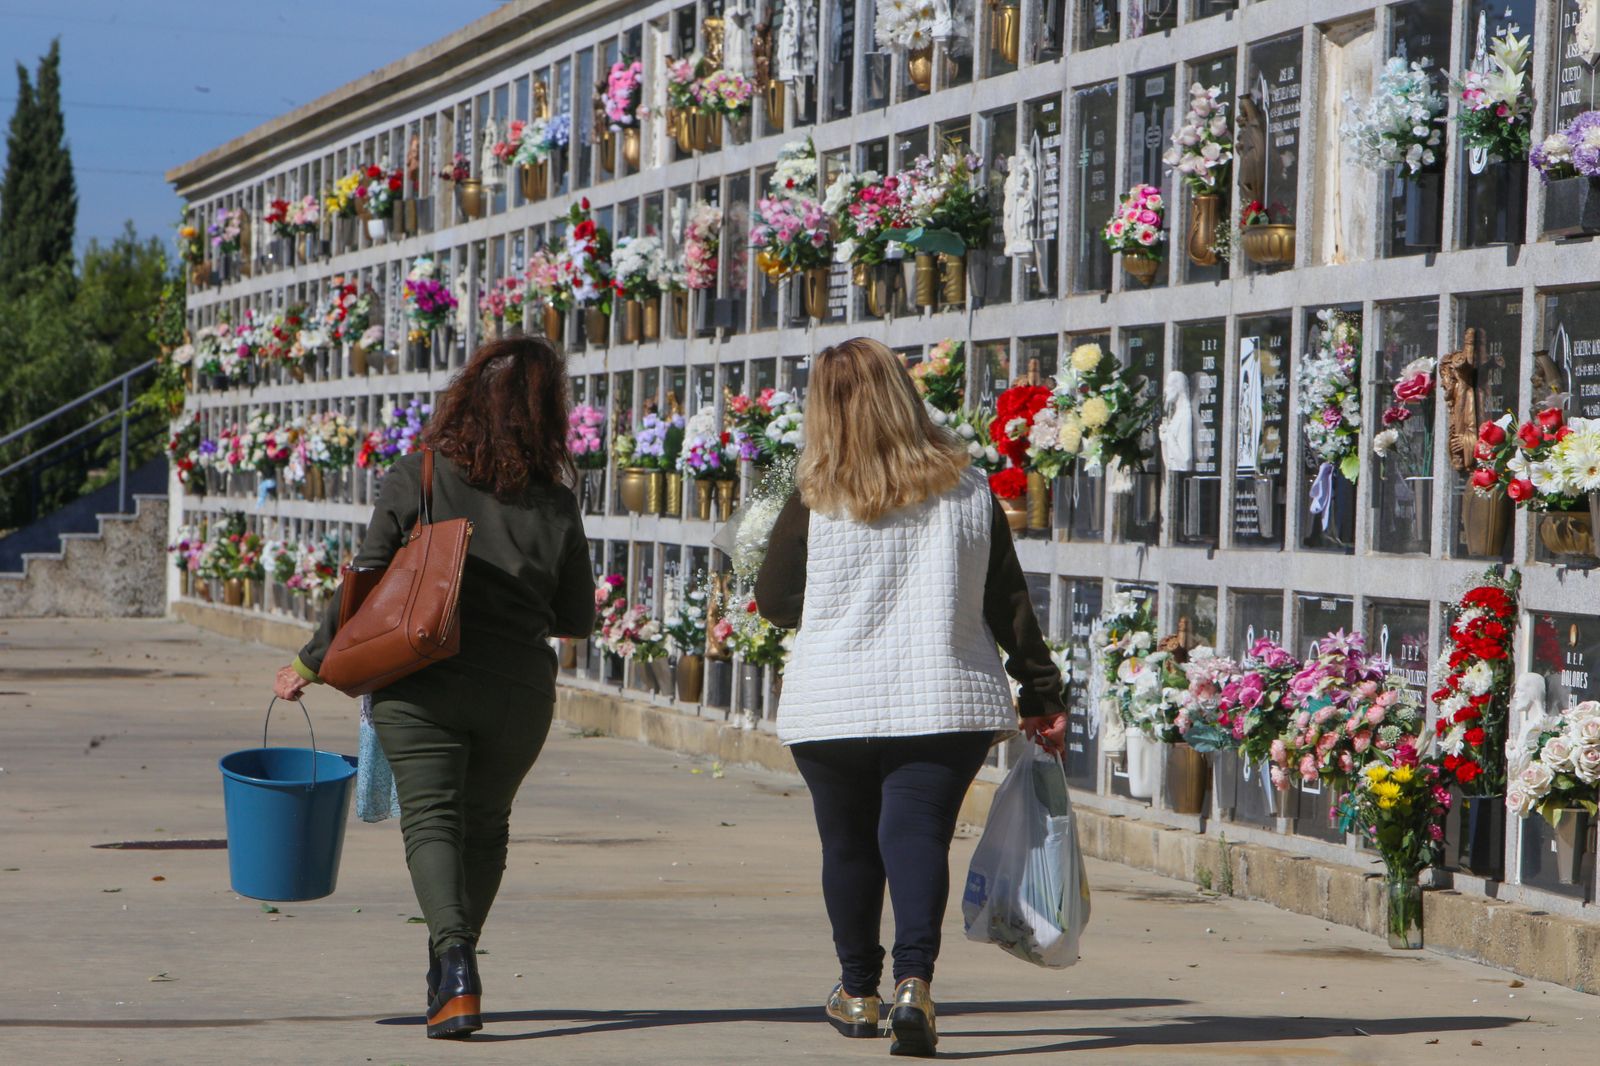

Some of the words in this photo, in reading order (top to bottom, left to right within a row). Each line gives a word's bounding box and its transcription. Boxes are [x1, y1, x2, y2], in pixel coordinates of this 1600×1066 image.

[1562, 65, 1582, 83] CUETO
[1560, 87, 1581, 107] MUÑOZ
[1561, 669, 1588, 689] DOLORES
